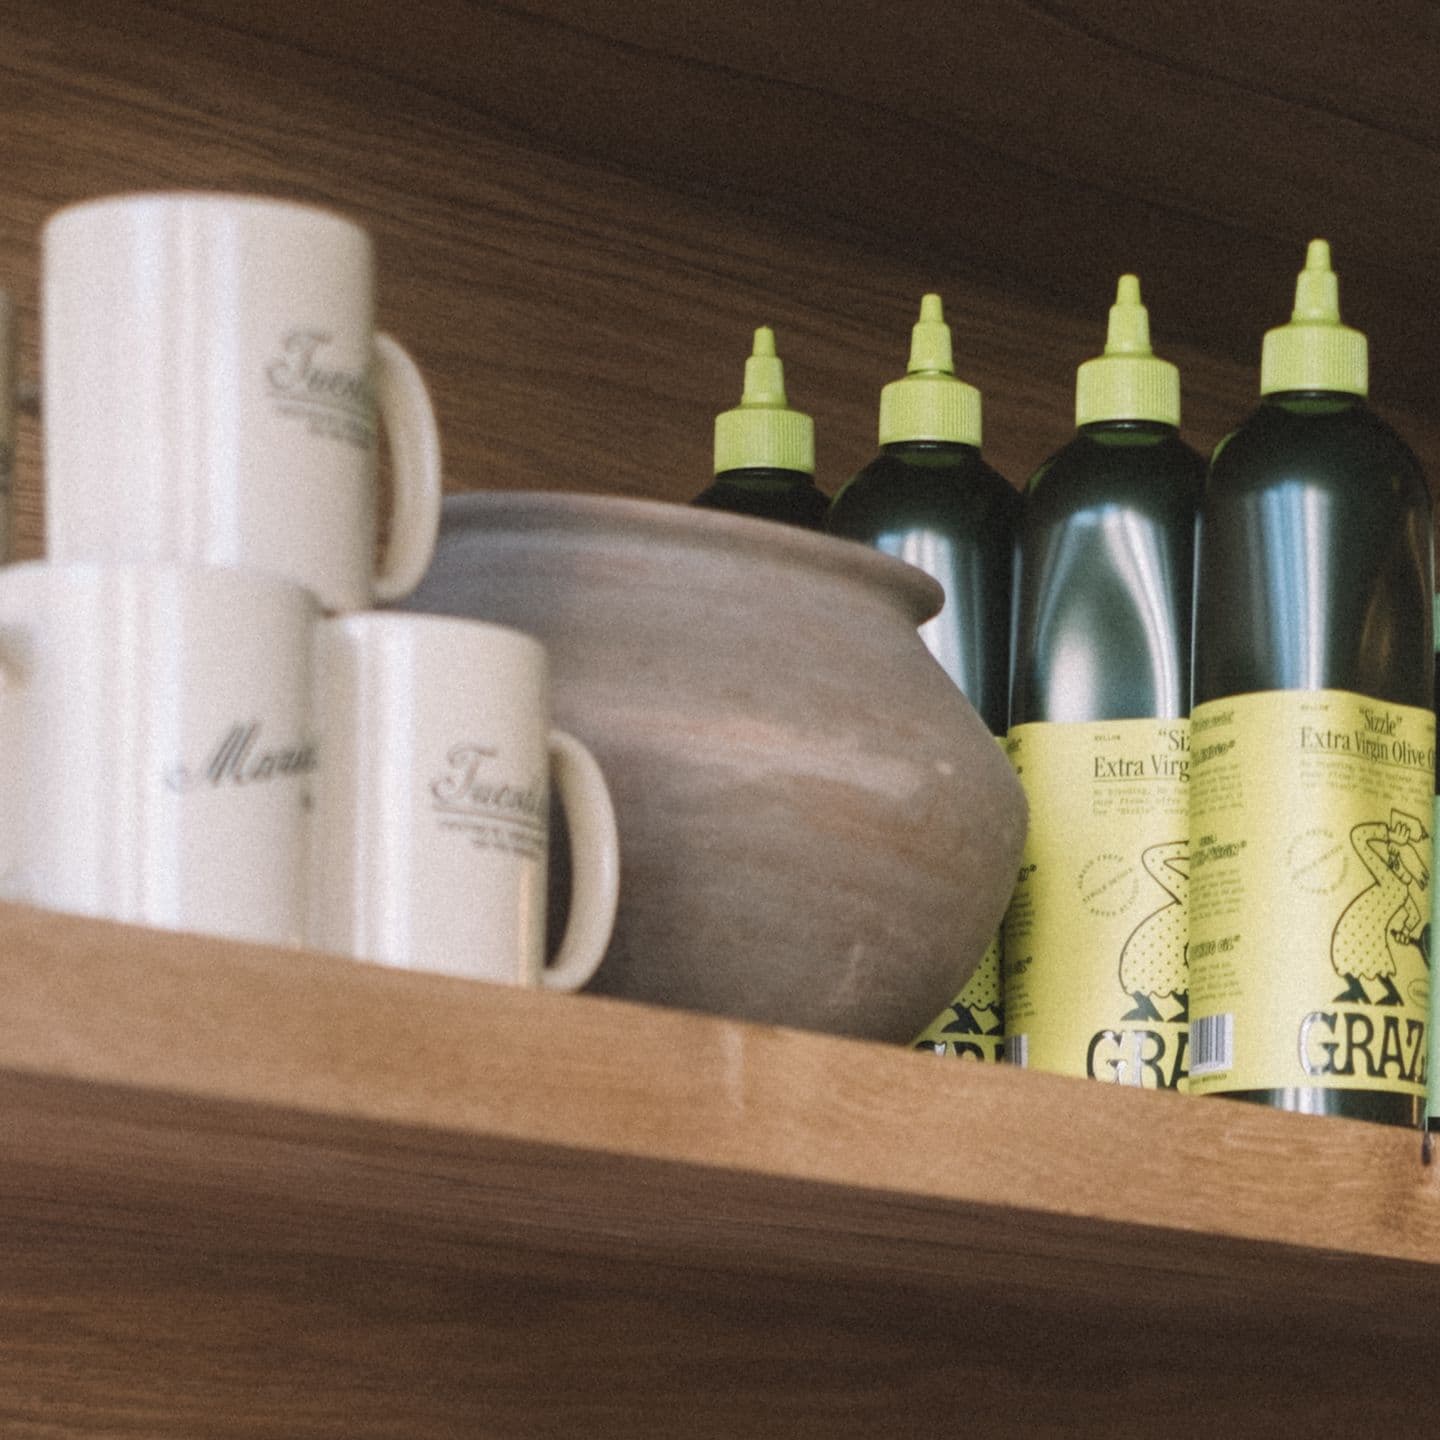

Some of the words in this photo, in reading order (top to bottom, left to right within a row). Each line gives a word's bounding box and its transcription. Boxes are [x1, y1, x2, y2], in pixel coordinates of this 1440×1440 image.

[1301, 726, 1350, 750] Extra
[1354, 730, 1389, 763] Virgin
[1392, 740, 1426, 767] Olive
[1093, 756, 1144, 778] Extra
[1151, 753, 1191, 784] Virg
